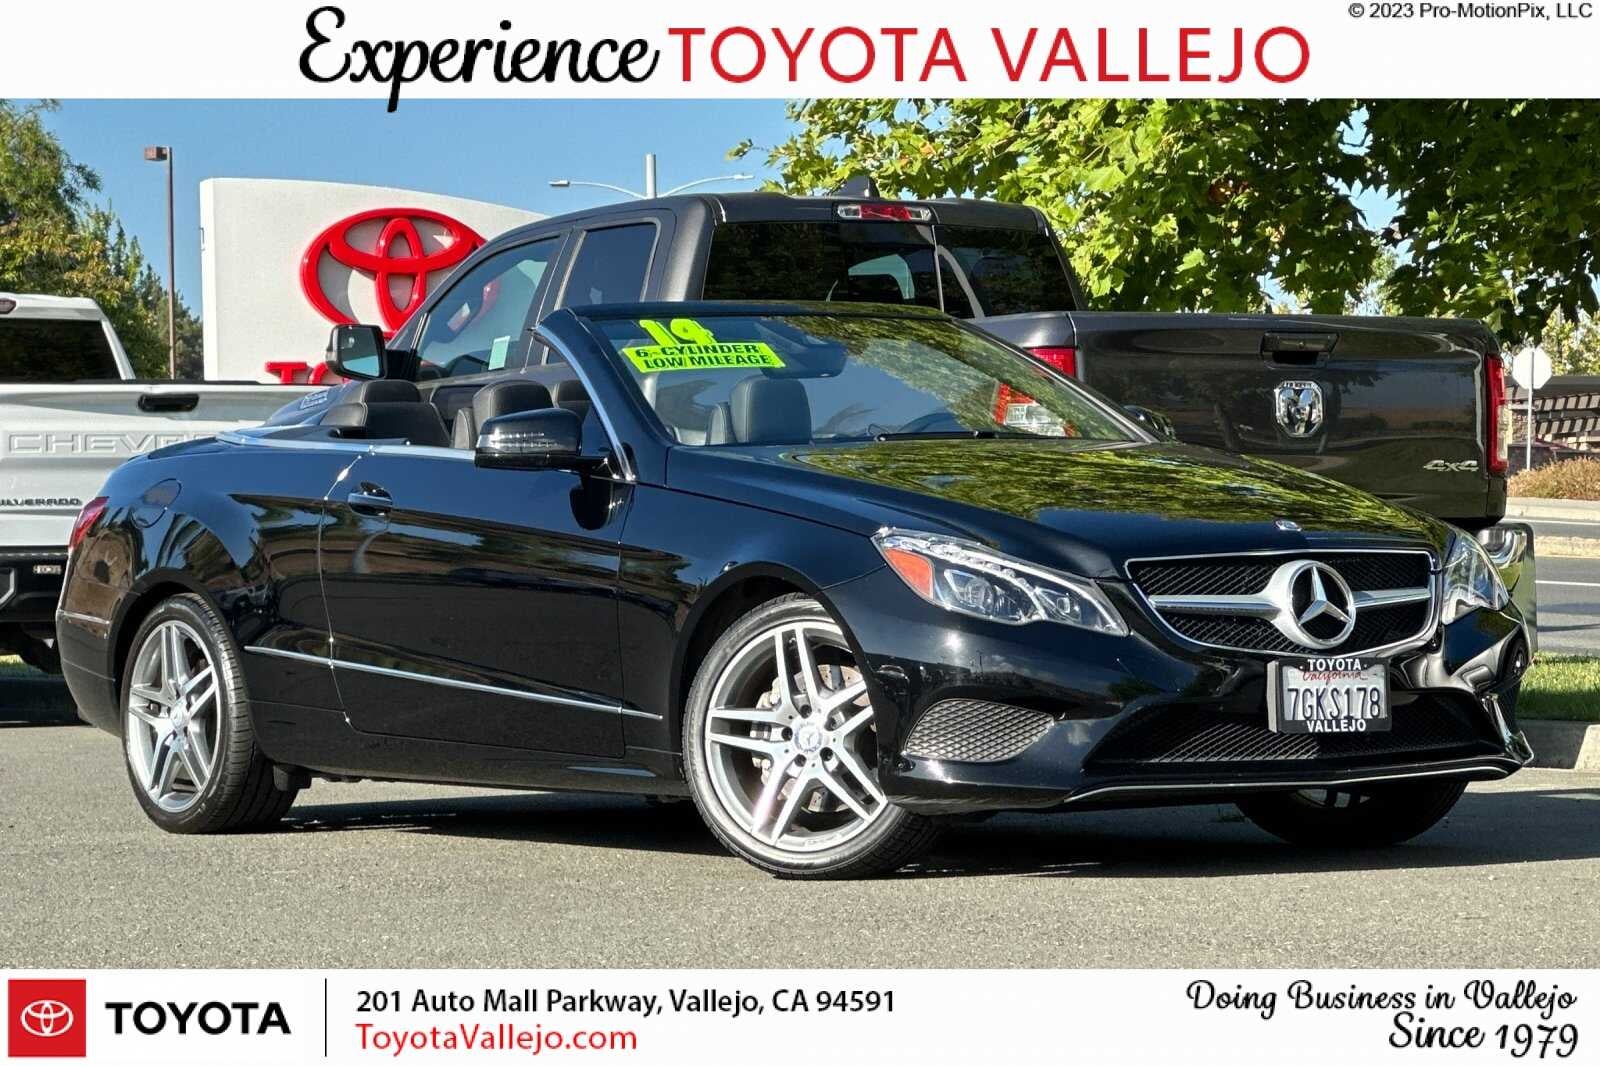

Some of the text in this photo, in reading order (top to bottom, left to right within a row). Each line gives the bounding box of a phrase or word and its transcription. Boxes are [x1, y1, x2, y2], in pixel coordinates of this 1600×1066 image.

[644, 354, 774, 369] LOW MILEAGE
[0, 498, 83, 506] ILVERADO
[1307, 658, 1361, 671] TOYOTA
[1287, 687, 1381, 720] 7GKS178
[1306, 719, 1367, 733] VALLEJO
